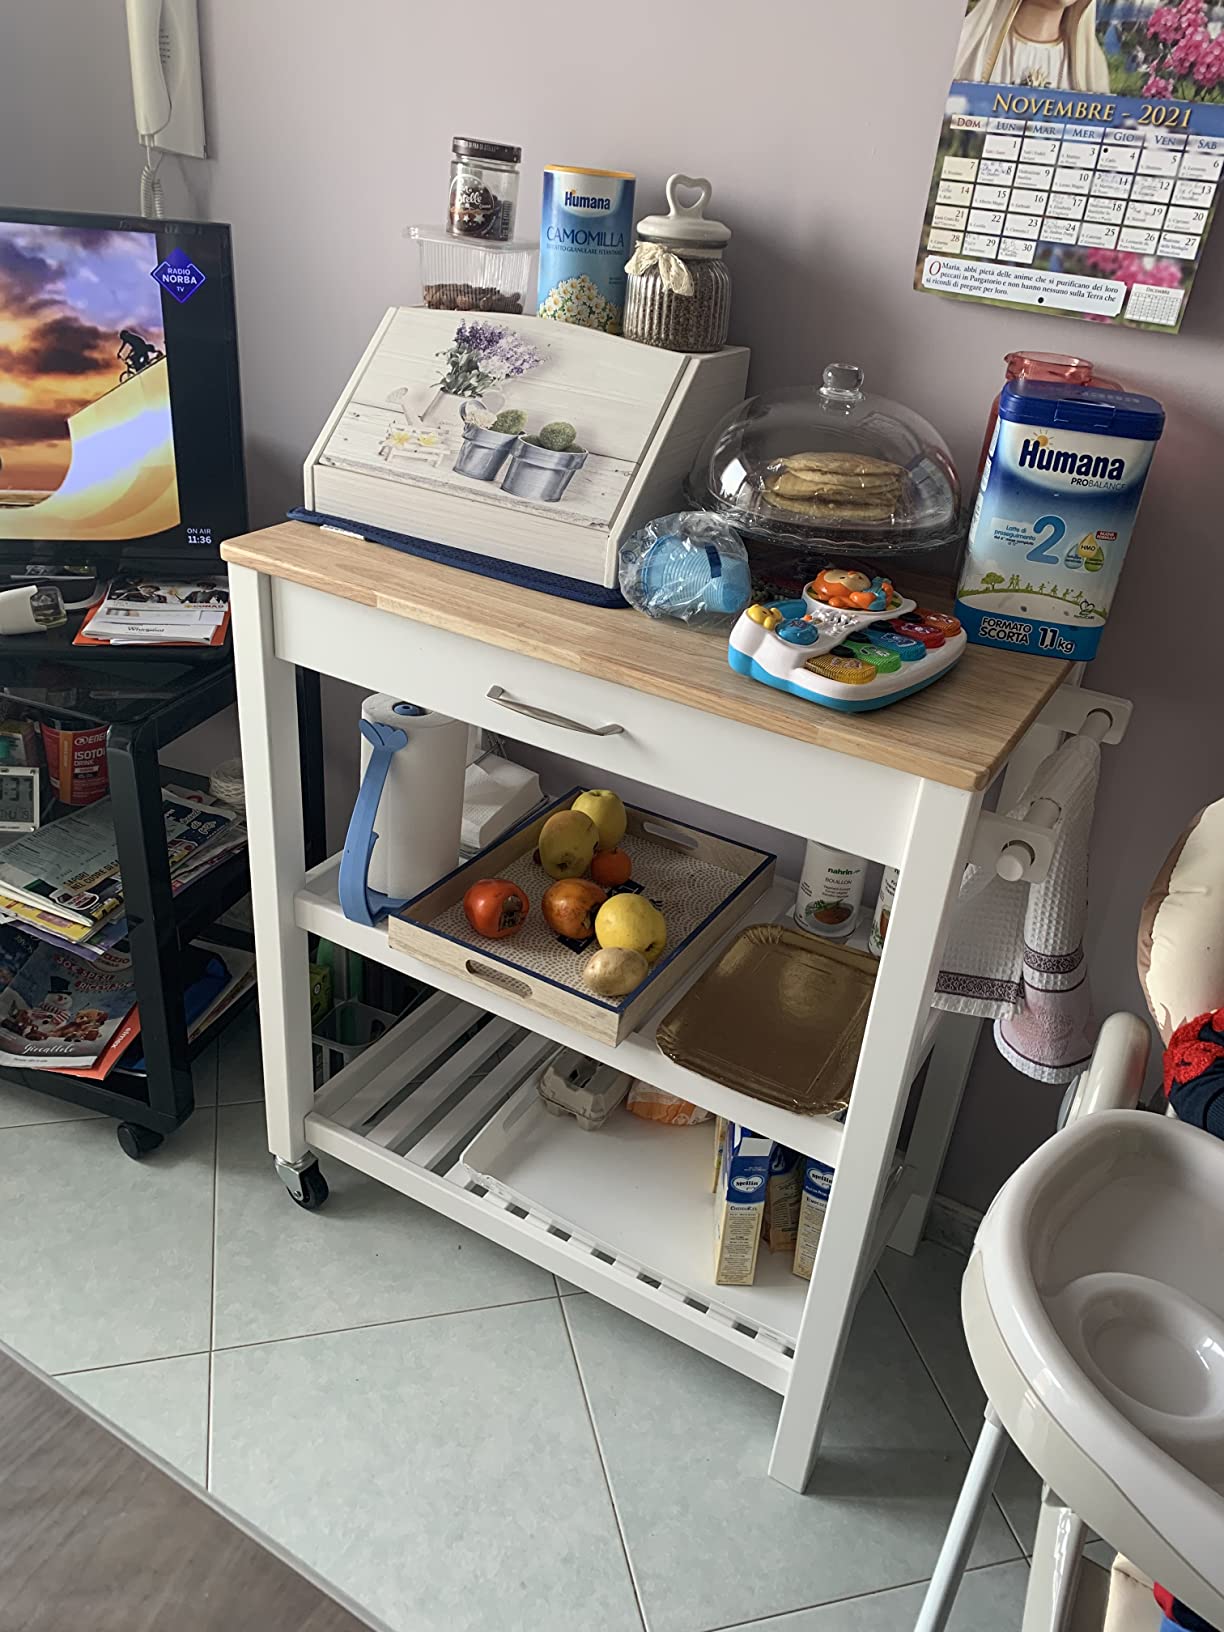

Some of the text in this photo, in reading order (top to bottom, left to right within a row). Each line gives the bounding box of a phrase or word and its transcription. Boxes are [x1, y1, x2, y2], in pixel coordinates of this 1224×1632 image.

[992, 93, 1116, 122] NOVEMBRE
[1138, 104, 1192, 128] 2021
[957, 117, 1218, 150] DOM LUN MAR MER GIO VEN SAB
[1012, 140, 1220, 168] 1 2 3 4 5 6
[1006, 166, 1012, 175] 8
[1044, 169, 1050, 177] 9
[1079, 173, 1089, 181] 10
[1159, 181, 1170, 190] 12
[1201, 185, 1212, 195] 13
[565, 190, 611, 210] Humana
[960, 186, 970, 194] 14
[997, 190, 1007, 199] 15
[1034, 194, 1044, 203] 16
[1072, 198, 1083, 207] 17
[1112, 201, 1122, 212] 18
[1152, 207, 1163, 216] 19
[1192, 212, 1204, 221] 20
[546, 226, 625, 247] CAMOMILLA
[955, 210, 965, 219] 21
[991, 214, 1002, 223] 22
[1028, 219, 1038, 228] 23
[1065, 223, 1076, 232] 24
[1104, 228, 1115, 237] 25
[1144, 232, 1155, 241] 26
[1185, 237, 1197, 247] 27
[950, 234, 961, 243] 28
[986, 239, 997, 247] 29
[1022, 243, 1033, 252] 30
[162, 274, 197, 284] NORBA
[167, 267, 191, 275] RADIO
[929, 261, 941, 276] O
[963, 264, 977, 274] abbi
[996, 268, 1012, 278] delle
[1014, 273, 1033, 282] anime
[1035, 274, 1047, 283] che
[1055, 279, 1090, 289] purificano
[1092, 283, 1103, 291] dei
[1105, 285, 1119, 294] loro
[932, 277, 952, 287] ricordi
[952, 279, 959, 288] di
[960, 282, 983, 293] pregare
[983, 285, 994, 294] per
[940, 271, 962, 280] peccati
[962, 273, 969, 281] in
[969, 274, 1002, 286] Purgatorio
[1007, 281, 1020, 289] non
[1021, 283, 1041, 292] hanno
[1042, 286, 1069, 296] nessuno
[1069, 289, 1085, 298] sulla
[1086, 291, 1103, 301] Terra
[1104, 294, 1117, 303] che
[1018, 438, 1126, 481] Humana
[1070, 477, 1127, 491] PROBALANCE
[188, 536, 212, 544] 11:36
[994, 530, 1036, 542] proseguimento
[1026, 515, 1066, 565] 2
[1081, 544, 1096, 552] HMO
[978, 625, 1031, 646] SCORTA
[982, 617, 1032, 634] FORMATO
[74, 748, 106, 760] ISOTO
[828, 867, 853, 875] nahrin
